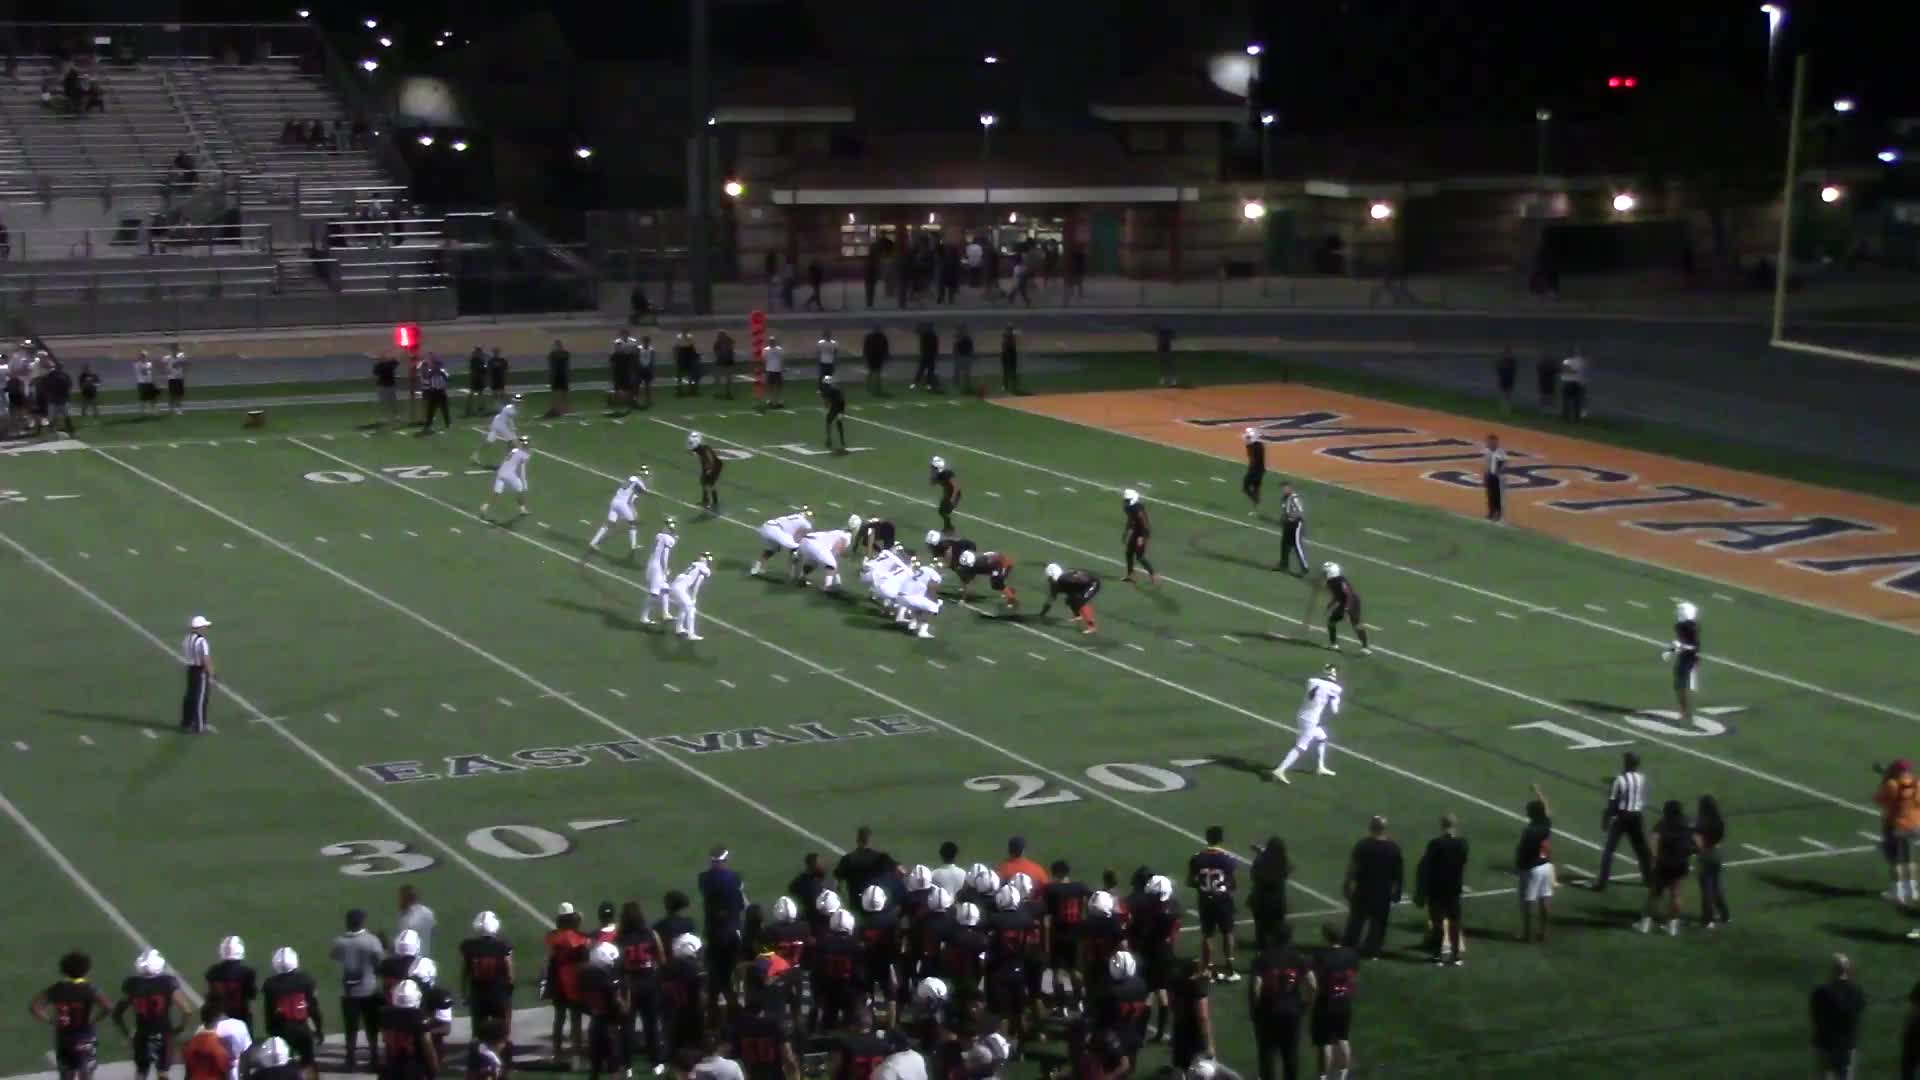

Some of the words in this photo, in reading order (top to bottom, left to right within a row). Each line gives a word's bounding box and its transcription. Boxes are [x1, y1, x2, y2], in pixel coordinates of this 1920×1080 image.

[302, 464, 449, 485] 20
[358, 714, 938, 786] EASTVALE
[963, 761, 1188, 810] 20
[320, 824, 571, 876] 30
